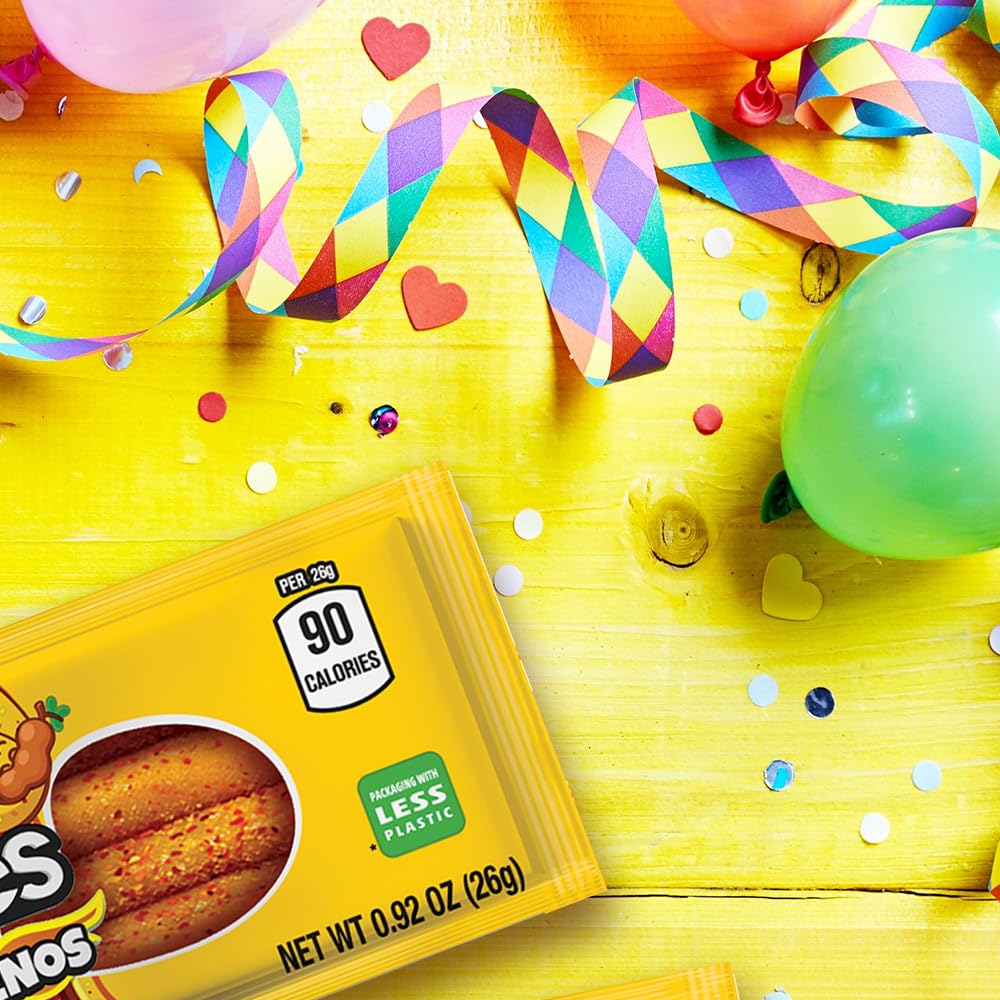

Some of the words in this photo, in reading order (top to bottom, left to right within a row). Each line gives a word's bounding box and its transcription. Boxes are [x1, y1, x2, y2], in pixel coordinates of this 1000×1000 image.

[278, 572, 307, 596] PER
[310, 564, 336, 584] 26g
[299, 601, 354, 655] 90
[304, 650, 382, 693] CALORIES
[369, 779, 416, 802] PACKAGING
[416, 768, 439, 787] WITH
[374, 783, 448, 826] LESS
[384, 807, 454, 842] PLASTIC
[276, 931, 324, 974] NET
[327, 915, 367, 953] WT
[370, 895, 425, 938] 0.92
[426, 881, 461, 920] OZ
[463, 856, 526, 908] (26g)
